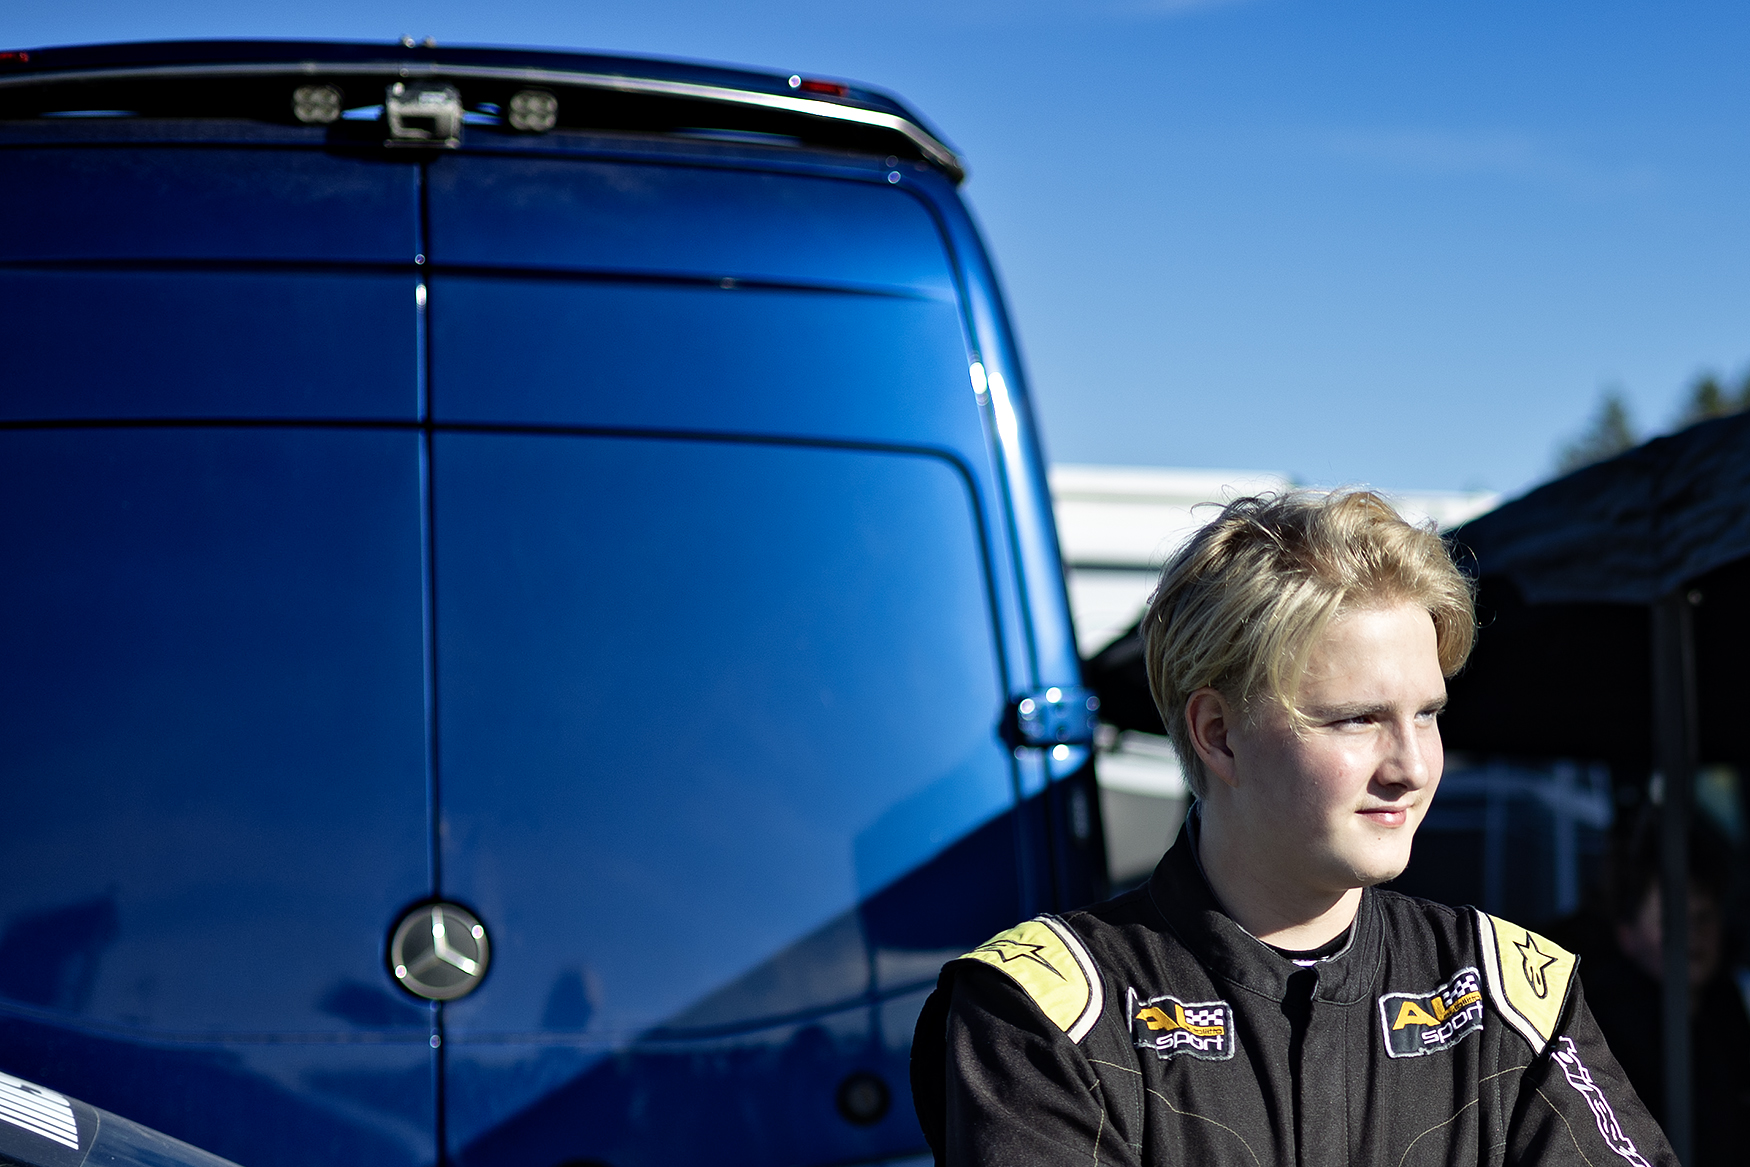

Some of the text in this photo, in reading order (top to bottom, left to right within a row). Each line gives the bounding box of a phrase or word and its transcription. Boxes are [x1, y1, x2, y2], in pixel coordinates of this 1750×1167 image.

[1392, 992, 1482, 1031] AL
[1421, 1000, 1483, 1044] sport
[1156, 1031, 1224, 1051] sport
